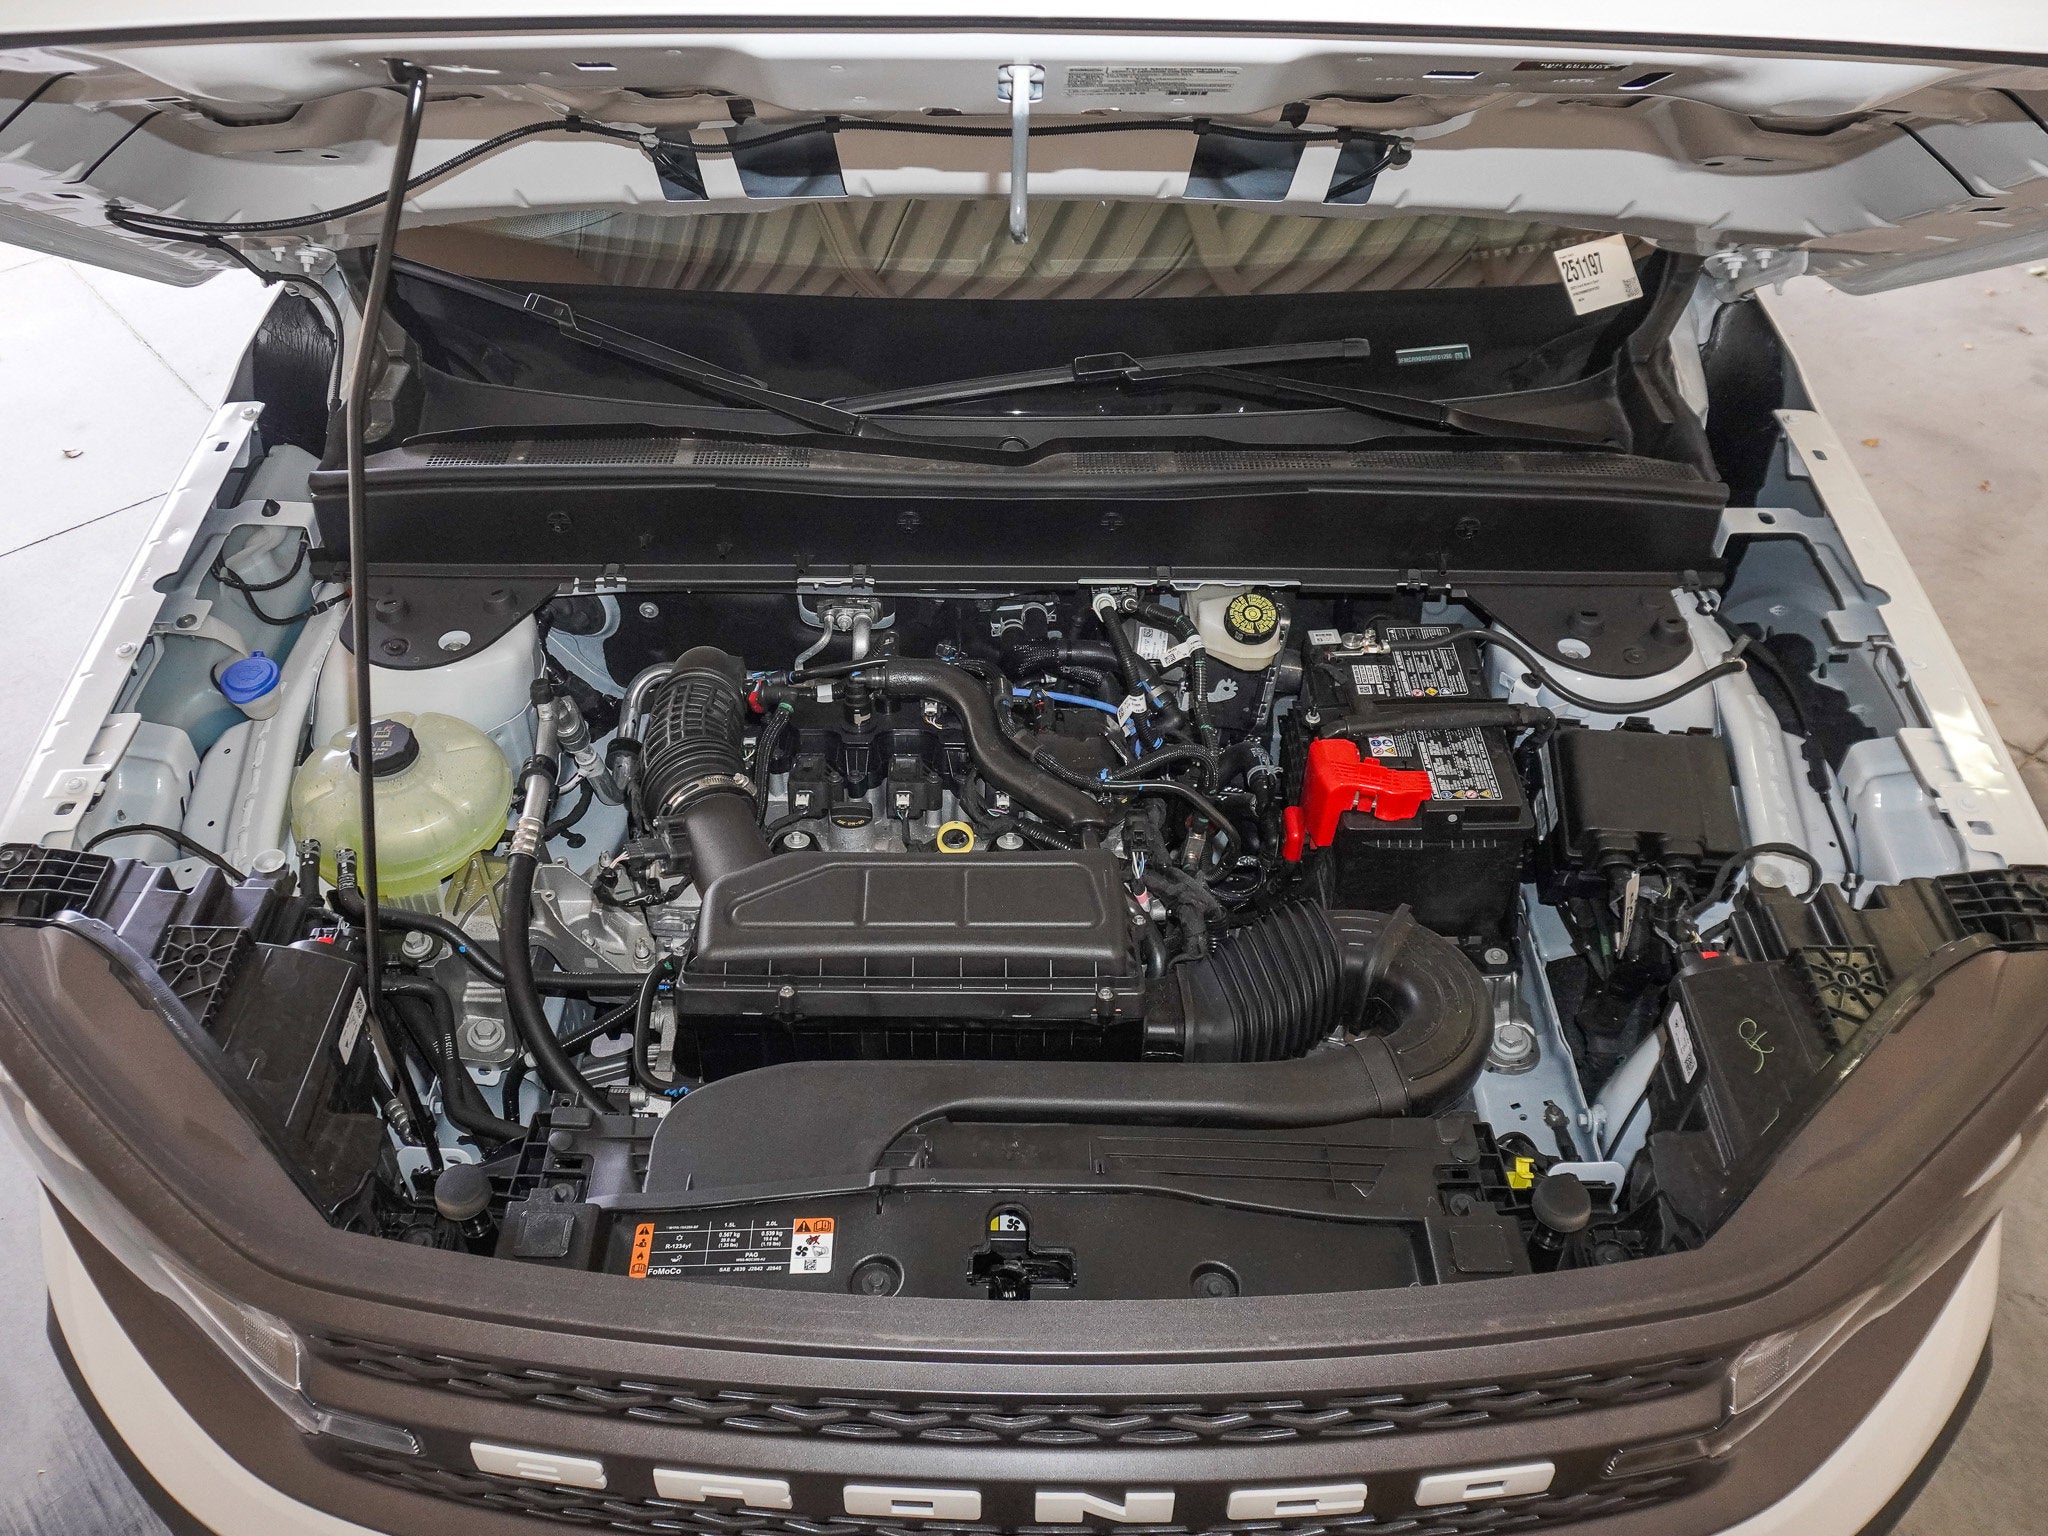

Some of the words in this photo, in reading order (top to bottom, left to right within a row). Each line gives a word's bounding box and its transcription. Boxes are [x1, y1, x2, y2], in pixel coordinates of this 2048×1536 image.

[1561, 252, 1604, 283] 251197
[665, 1242, 692, 1250] R-1234yf
[647, 1267, 682, 1275] FoMoCo
[469, 1441, 1556, 1523] BRONCO
